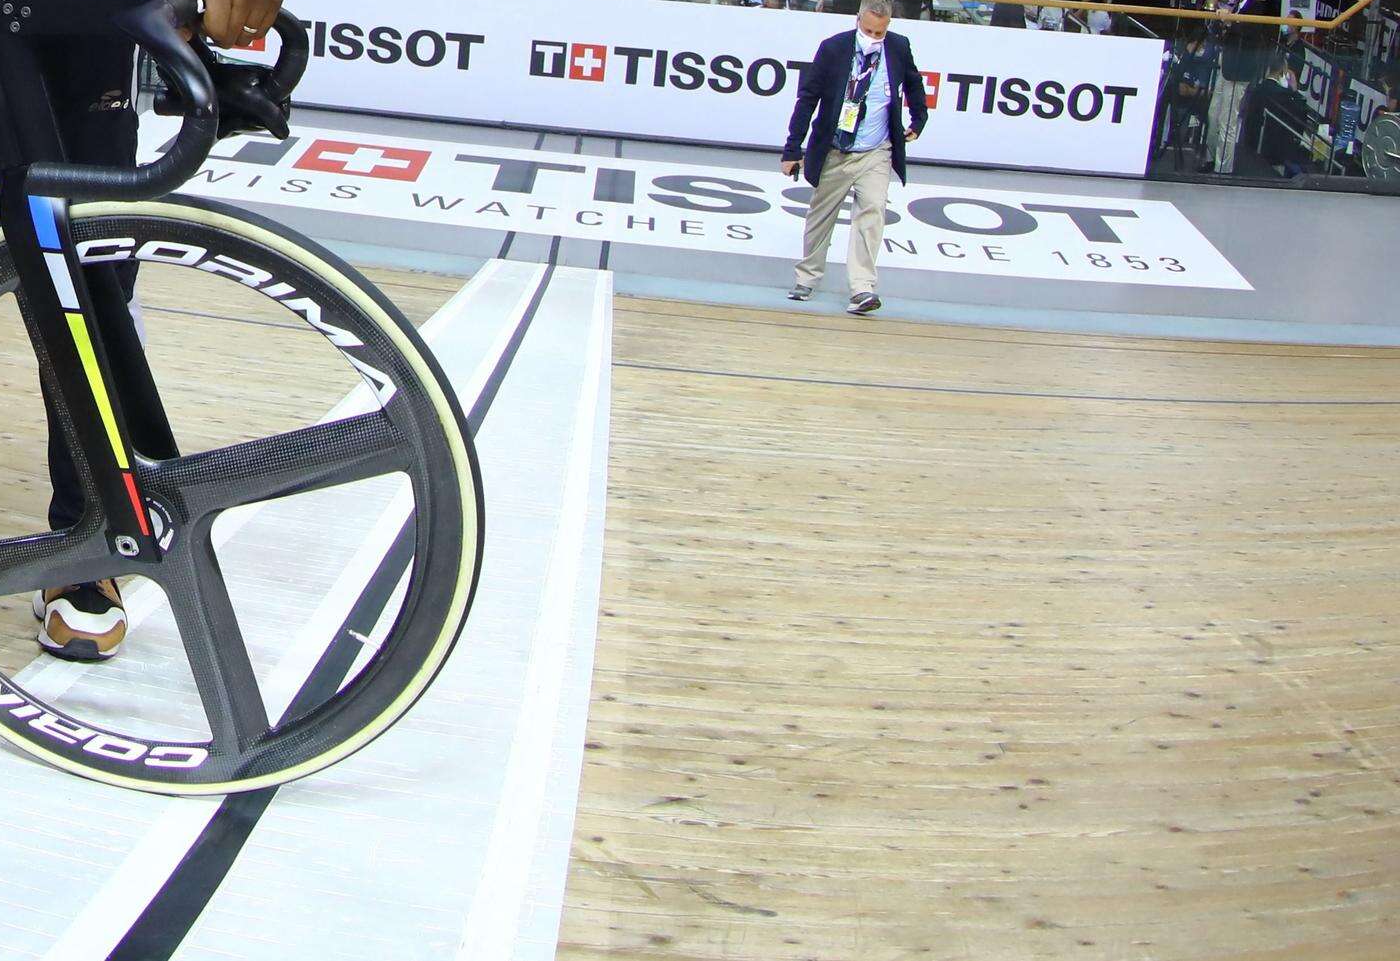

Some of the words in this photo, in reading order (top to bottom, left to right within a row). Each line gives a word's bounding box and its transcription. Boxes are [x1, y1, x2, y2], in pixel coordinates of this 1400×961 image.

[302, 19, 485, 71] ISSOT
[947, 72, 1138, 125] TISSOT
[190, 169, 364, 201] WISS
[411, 191, 756, 242] WATCHES
[884, 237, 1011, 262] NCE
[1050, 249, 1187, 274] 1853
[75, 238, 398, 410] CORIMA
